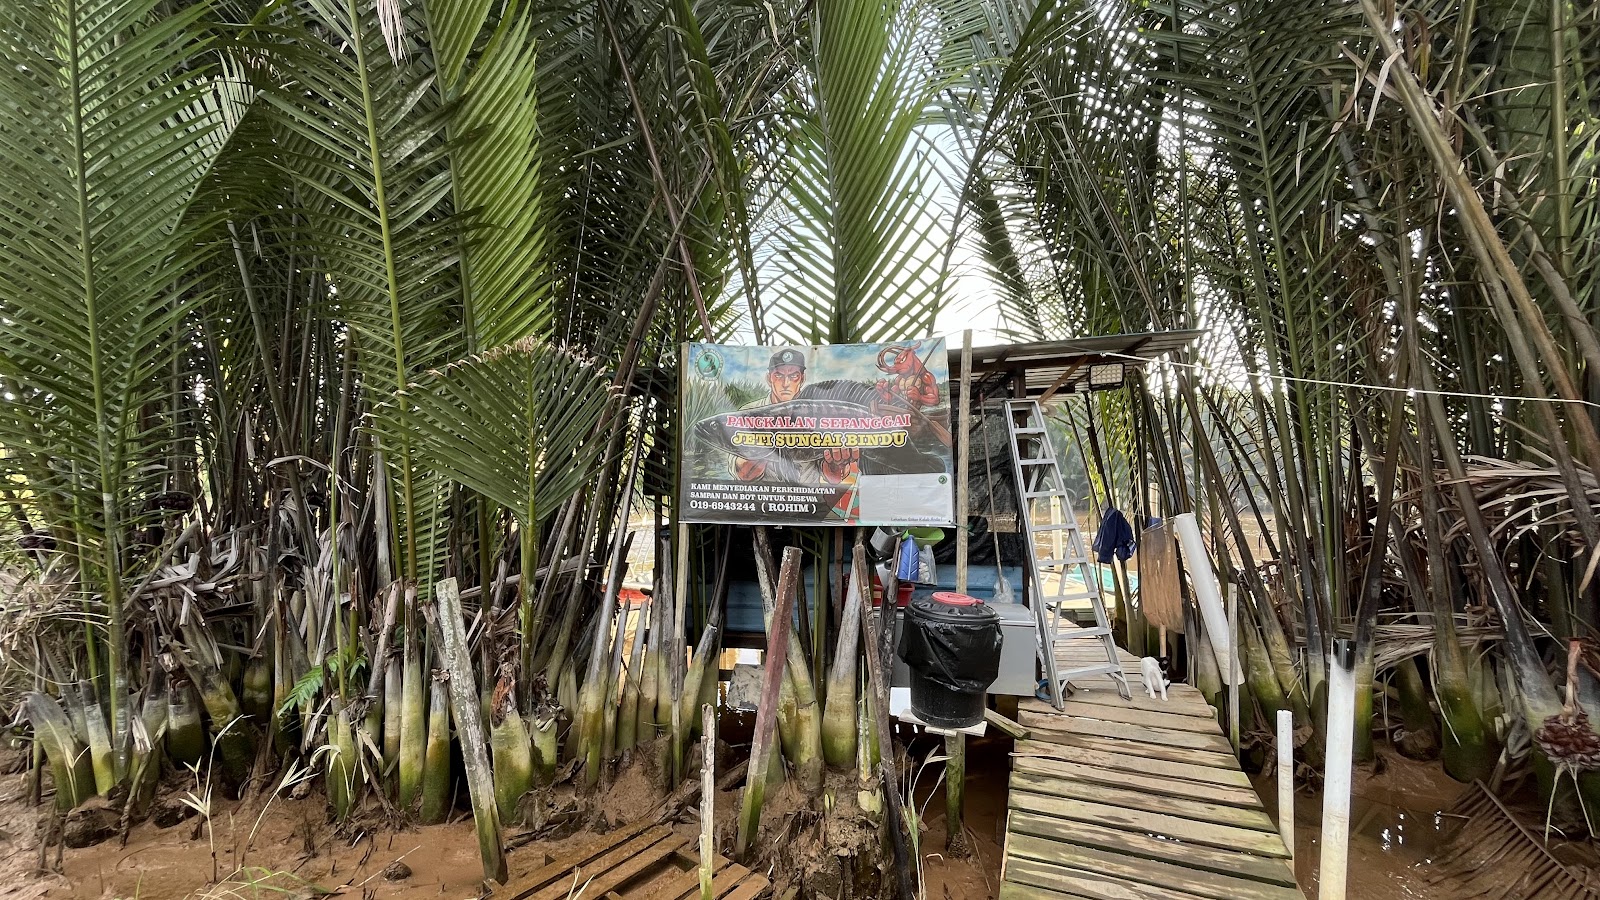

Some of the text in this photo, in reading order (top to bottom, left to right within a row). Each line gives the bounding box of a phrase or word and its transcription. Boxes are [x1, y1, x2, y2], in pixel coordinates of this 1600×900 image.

[727, 414, 911, 429] PANGKALAN SEPANGGAI
[732, 431, 907, 447] JETI SUNGAI BINDU
[690, 491, 721, 499] SAMPAN
[712, 484, 769, 493] MENYEDIAKAN
[771, 486, 836, 495] PERKHIDMATAN
